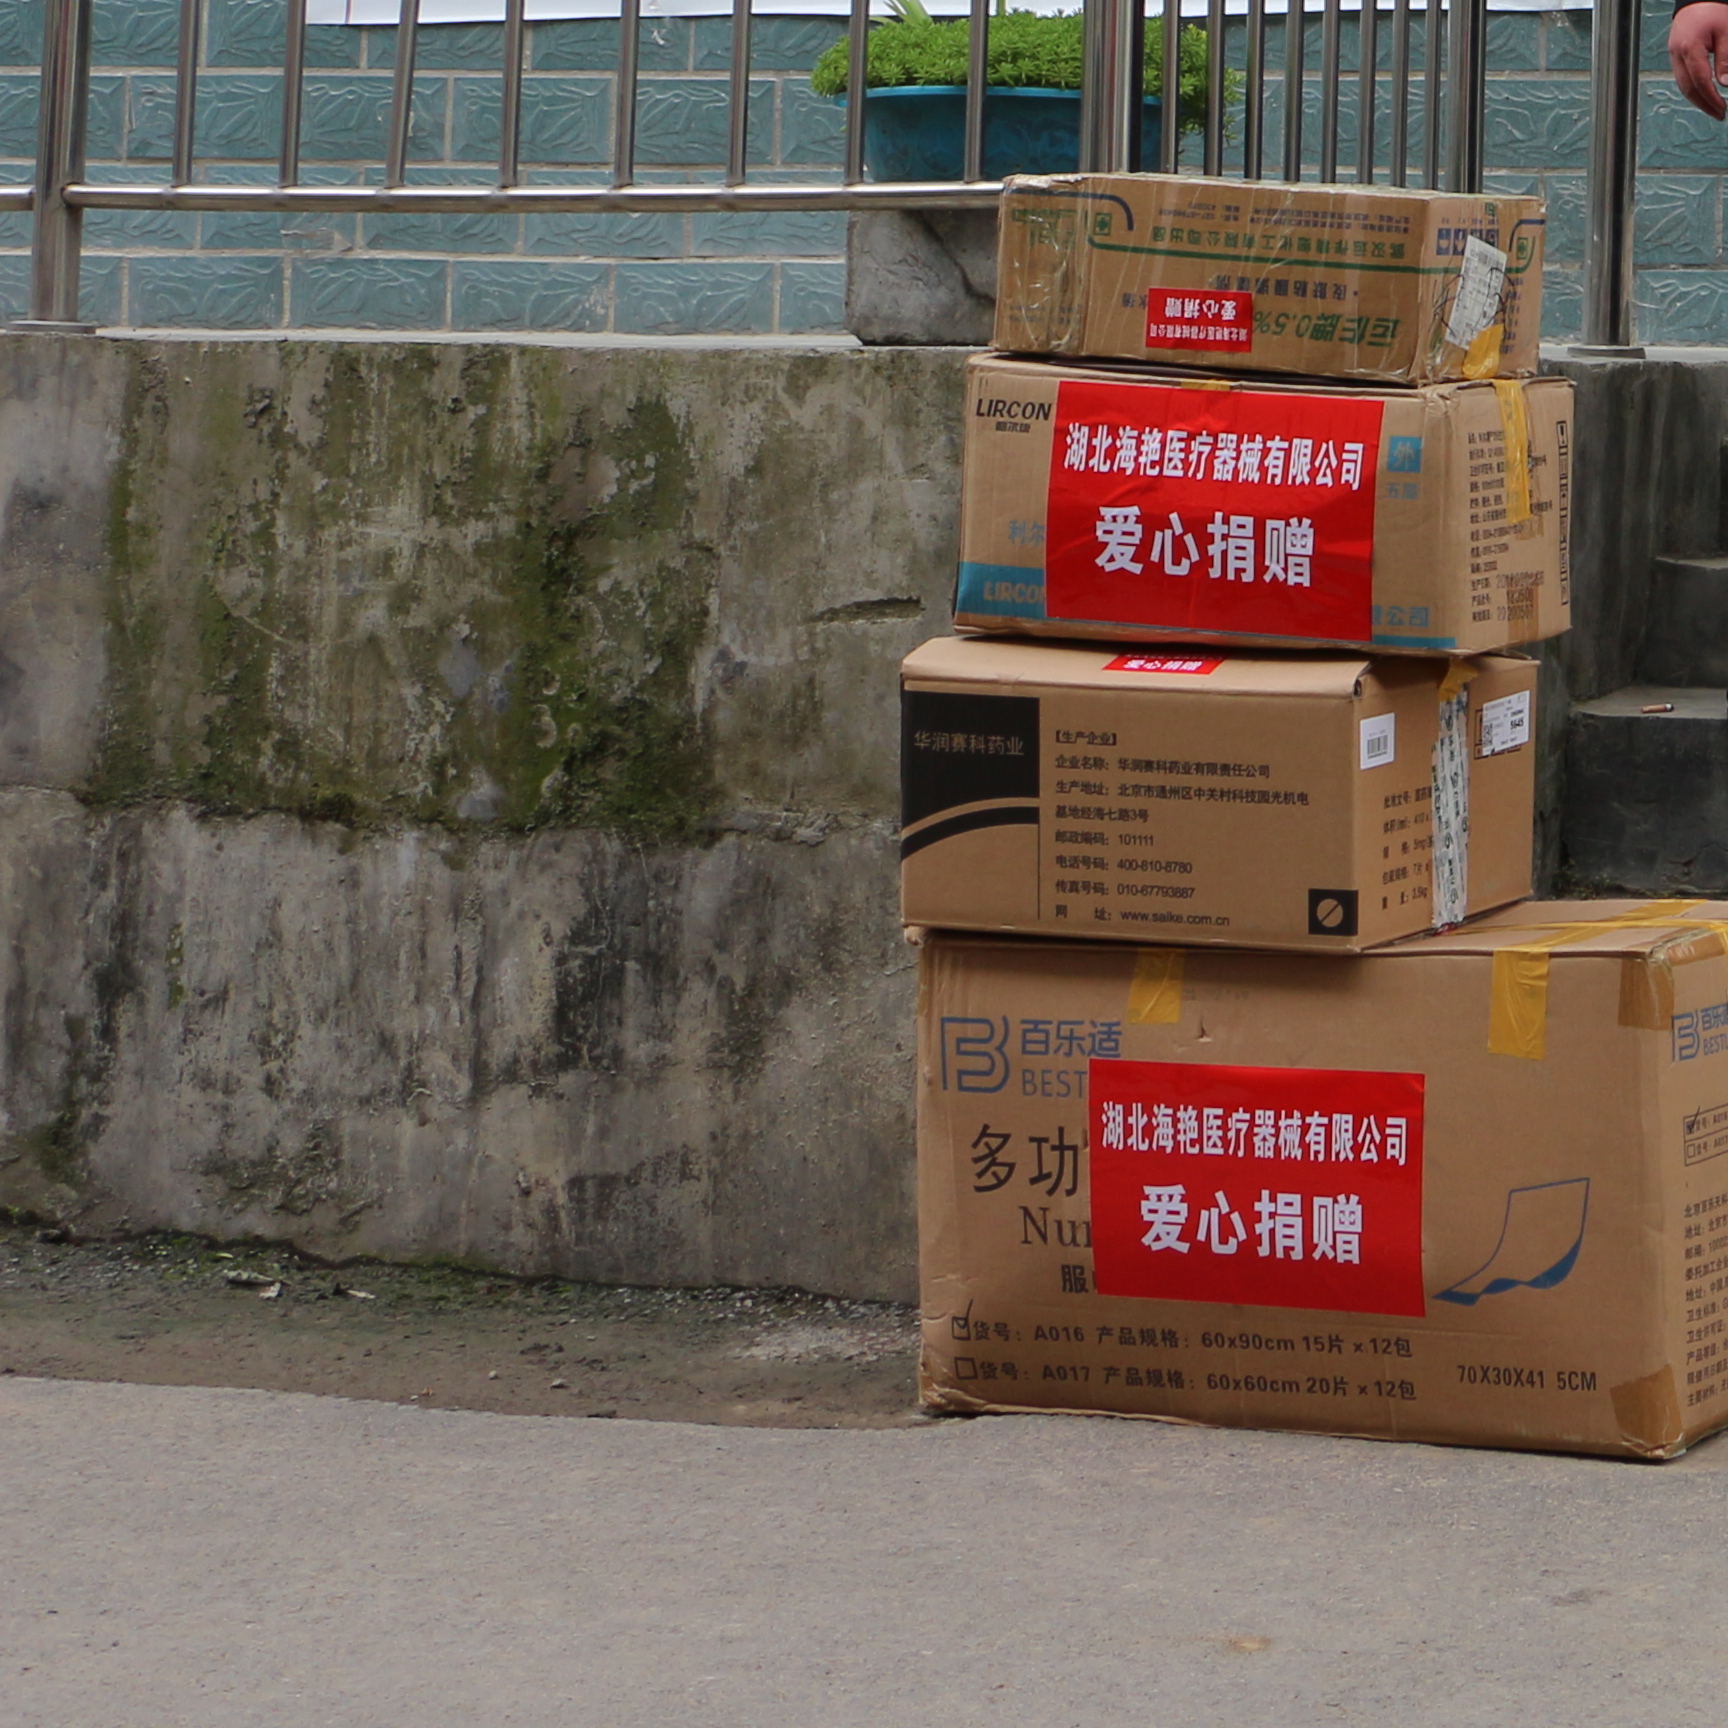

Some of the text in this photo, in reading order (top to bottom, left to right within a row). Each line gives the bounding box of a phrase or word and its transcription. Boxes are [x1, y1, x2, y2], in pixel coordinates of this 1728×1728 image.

[1165, 297, 1239, 322] 爱心捐赠
[1149, 323, 1248, 344] 湖北海艳医疗器械有限公司
[976, 398, 1053, 421] LIRCON
[1063, 422, 1366, 491] 湖北海艳医疗器械有限公司
[1391, 440, 1415, 466] 外
[1094, 504, 1316, 589] 爱心捐赠
[1123, 658, 1204, 672] 爱心捐赠
[913, 731, 1024, 756] 华润赛科药业
[1055, 729, 1117, 746] 【生产企业】
[1055, 755, 1271, 780] 企业名称： 华润赛科药业有限责任公司
[1055, 780, 1310, 807] 生产地址： 北京市通州区中关村科技园光机电
[1055, 805, 1150, 824] 基地经海七路3号
[1055, 830, 1155, 847] 邮政编码： 101111
[1055, 855, 1193, 875] 电话号码： 400-810-8780
[1055, 880, 1195, 900] 传真号码： 010-67793887
[1055, 906, 1068, 920] 网
[1120, 909, 1231, 927] www.saike.com.cn
[1019, 1018, 1123, 1059] 百乐适
[1101, 1101, 1408, 1165] 湖北海艳医疗器械有限公司
[970, 1123, 1079, 1197] 多功
[1140, 1184, 1364, 1264] 爱心捐赠
[972, 1319, 1022, 1343] 货号：
[1034, 1325, 1085, 1344] A016
[1096, 1327, 1190, 1351] 产品规格：
[1201, 1330, 1295, 1352] 60x90cm
[1303, 1333, 1345, 1354] 15片
[978, 1360, 1030, 1382] 货号：
[1042, 1364, 1091, 1384] A017
[1103, 1366, 1195, 1391] 产品规格：
[1206, 1372, 1300, 1394] 60x60cm
[1306, 1375, 1348, 1398] 20片
